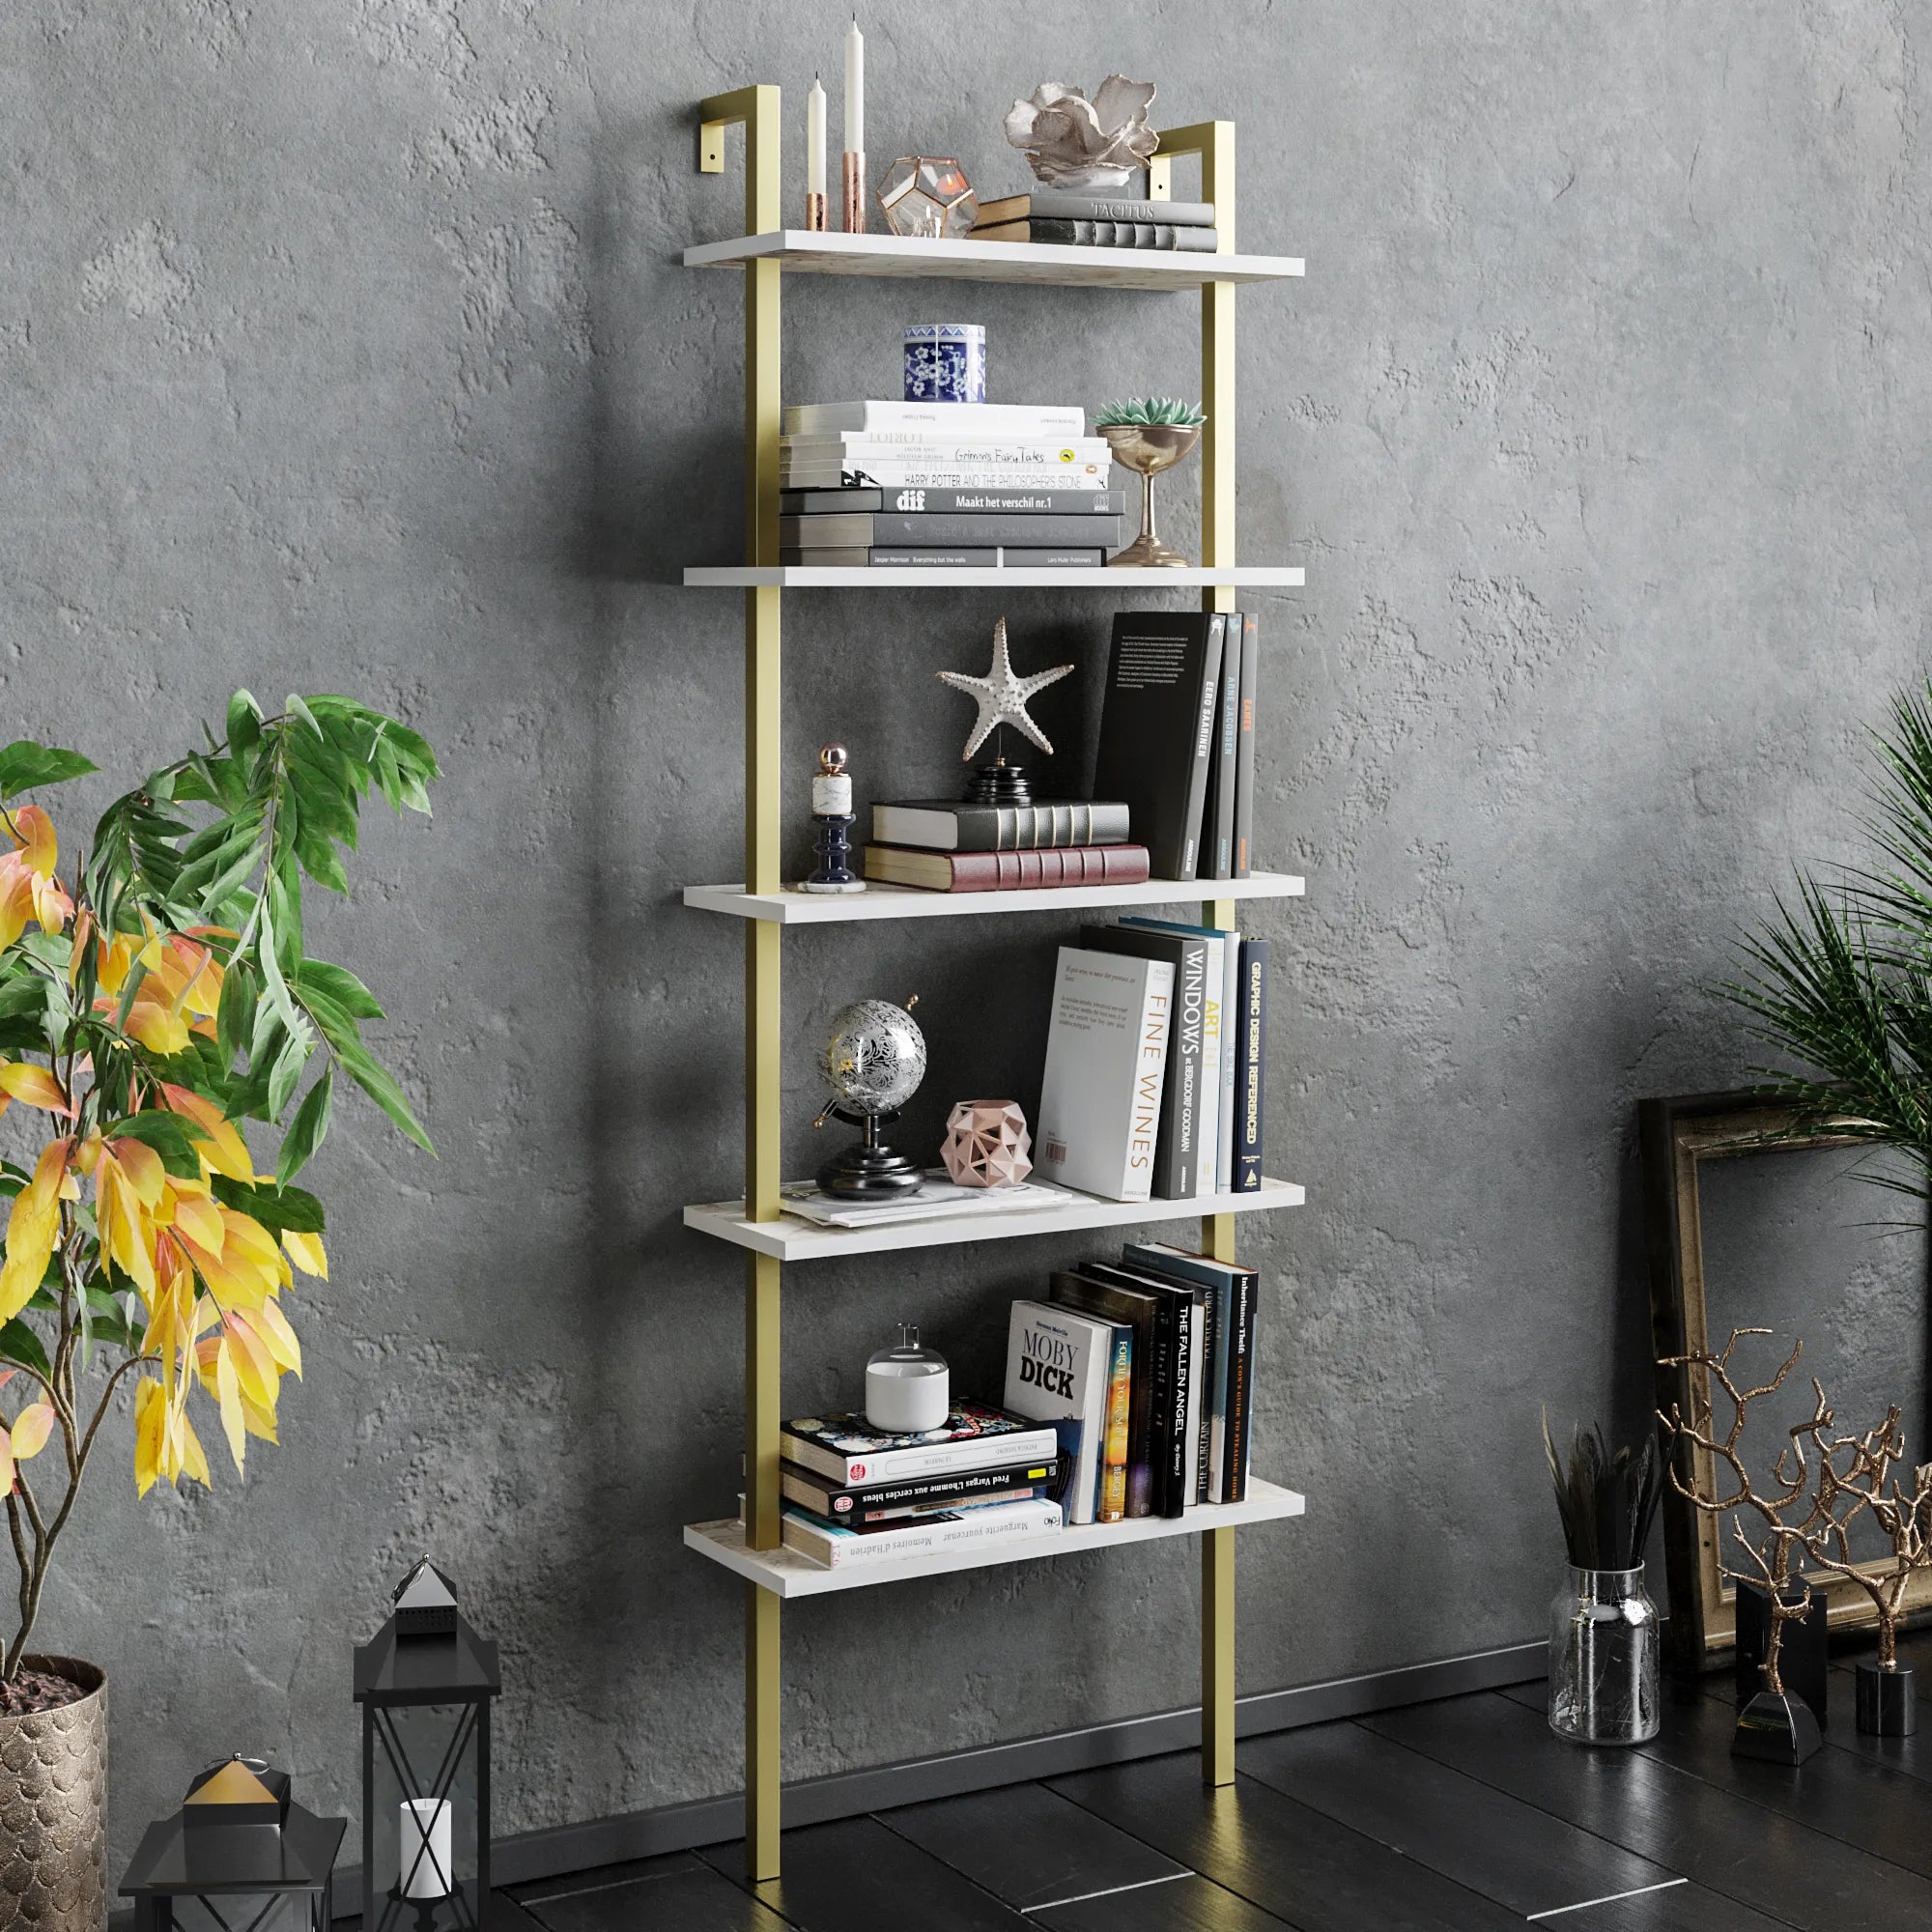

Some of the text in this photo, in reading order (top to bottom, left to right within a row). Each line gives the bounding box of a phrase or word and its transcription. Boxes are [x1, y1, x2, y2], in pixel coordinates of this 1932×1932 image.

[1092, 203, 1154, 219] TACITUS
[955, 446, 1044, 463] Grimm's Fairy Tales
[896, 490, 925, 511] dif
[905, 474, 928, 487] HARRY
[932, 474, 960, 487] POTTER
[964, 474, 980, 488] AND
[982, 475, 996, 488] THE
[1058, 475, 1082, 489] STONE
[956, 496, 1051, 508] Maakt het verschil nr.1
[1198, 681, 1215, 757] EERO SAARINEN
[1224, 676, 1236, 754] ARNE JACOBSEN
[1243, 698, 1252, 731] EAMES
[1181, 949, 1204, 1054] WINDOWS
[1250, 961, 1262, 1015] GRAPHIC
[1143, 995, 1167, 1059] FINE
[1205, 999, 1220, 1038] ART
[1249, 1018, 1260, 1063] DESIGN
[1183, 1065, 1194, 1108] BERGDORF
[1246, 1065, 1259, 1144] REFERENCED
[1130, 1074, 1157, 1169] WINES
[1180, 1108, 1192, 1152] GOODMAN
[1239, 1277, 1248, 1327] Inheritance
[1023, 1329, 1079, 1371] MOBY
[1117, 1340, 1128, 1381] FORTIFY
[1020, 1355, 1074, 1400] DICK
[1175, 1306, 1189, 1436] THE FALLEN ANGEL
[1114, 1384, 1126, 1414] YOUR
[1235, 1420, 1240, 1432] TO
[1198, 1421, 1210, 1490] THE CURTAIN
[863, 1492, 884, 1503] bleus
[885, 1488, 913, 1499] cercles
[930, 1481, 964, 1493] L'homme
[965, 1477, 991, 1489] Vargas
[992, 1474, 1010, 1485] Fred
[1112, 1465, 1122, 1498] BERGEY
[850, 1536, 932, 1556] Memoires d'Hadrien
[943, 1521, 1029, 1542] Marguerite yourcenar
